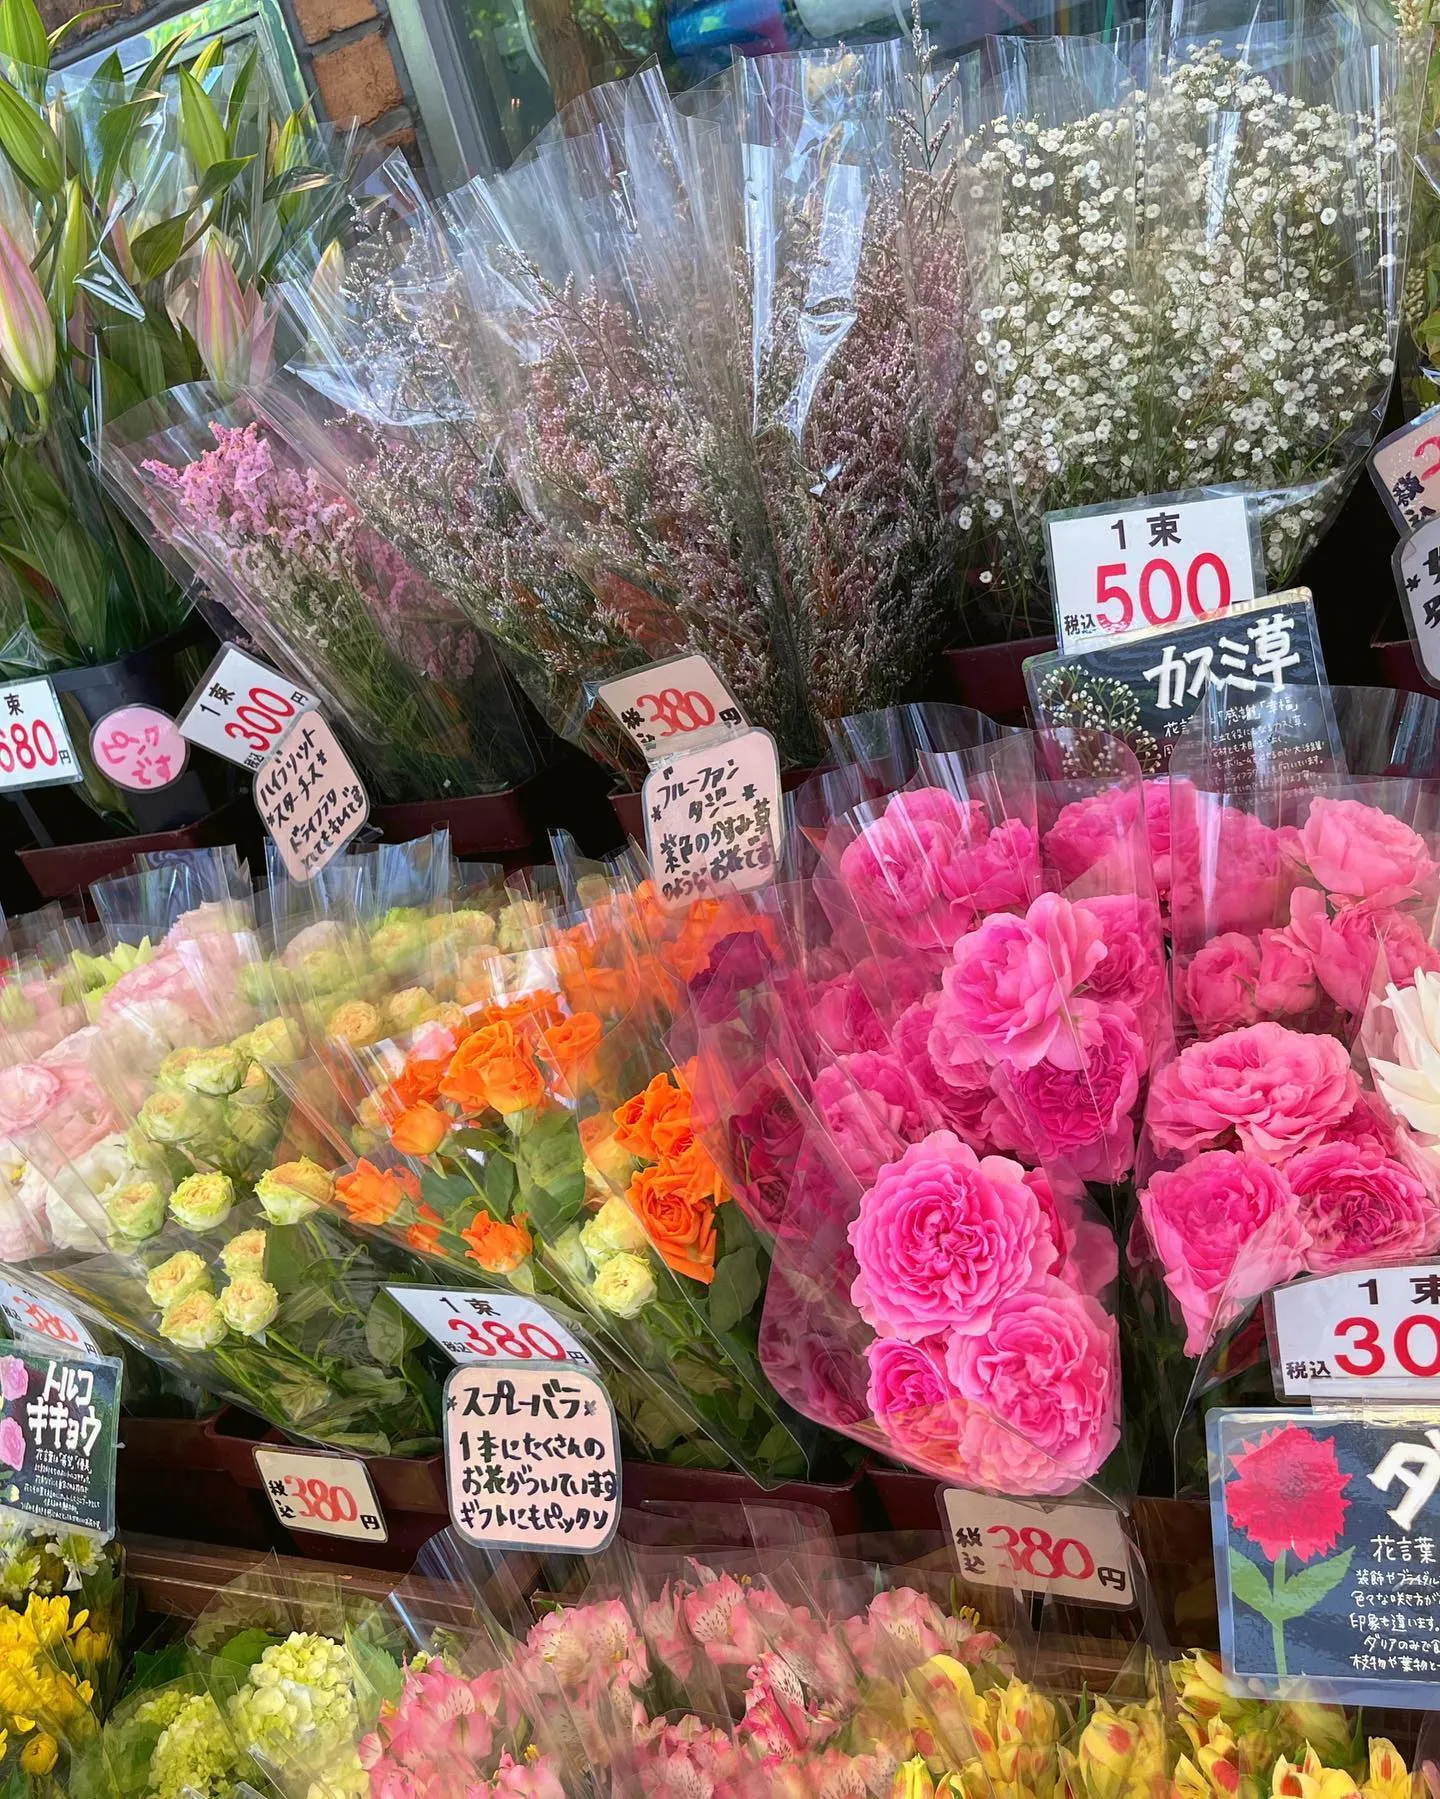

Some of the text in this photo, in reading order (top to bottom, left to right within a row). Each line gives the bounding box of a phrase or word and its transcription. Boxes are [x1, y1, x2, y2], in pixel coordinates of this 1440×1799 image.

[1064, 552, 1231, 636] 税込 500
[1142, 614, 1300, 710] カスミ草
[224, 687, 295, 751] 300
[290, 691, 309, 706] 円
[637, 688, 716, 737] 380
[718, 707, 742, 726] 円
[59, 749, 71, 767] 円
[101, 725, 160, 765] ピンク
[131, 756, 171, 785] です
[13, 1296, 79, 1344] 380
[448, 1318, 567, 1361] 380
[566, 1350, 590, 1364] 円
[1286, 1314, 1440, 1379] 税込 30
[42, 1360, 94, 1406] トルコ
[461, 1378, 582, 1419] スプレーバラ
[26, 1396, 102, 1456] キキョウ
[459, 1430, 605, 1463] 1本にたくさんの
[284, 1475, 358, 1522] 380
[360, 1514, 380, 1530] 円
[462, 1464, 617, 1502] お花がついています
[460, 1499, 609, 1533] ギフトにもピッタリ
[986, 1525, 1095, 1582] 380
[1097, 1566, 1126, 1592] 円
[1370, 1534, 1436, 1563] 花言葉
[1351, 1590, 1440, 1607] 色々な咲き方が
[1356, 1568, 1440, 1586] 装飾やブライダル
[1349, 1612, 1440, 1632] 印象も違います。
